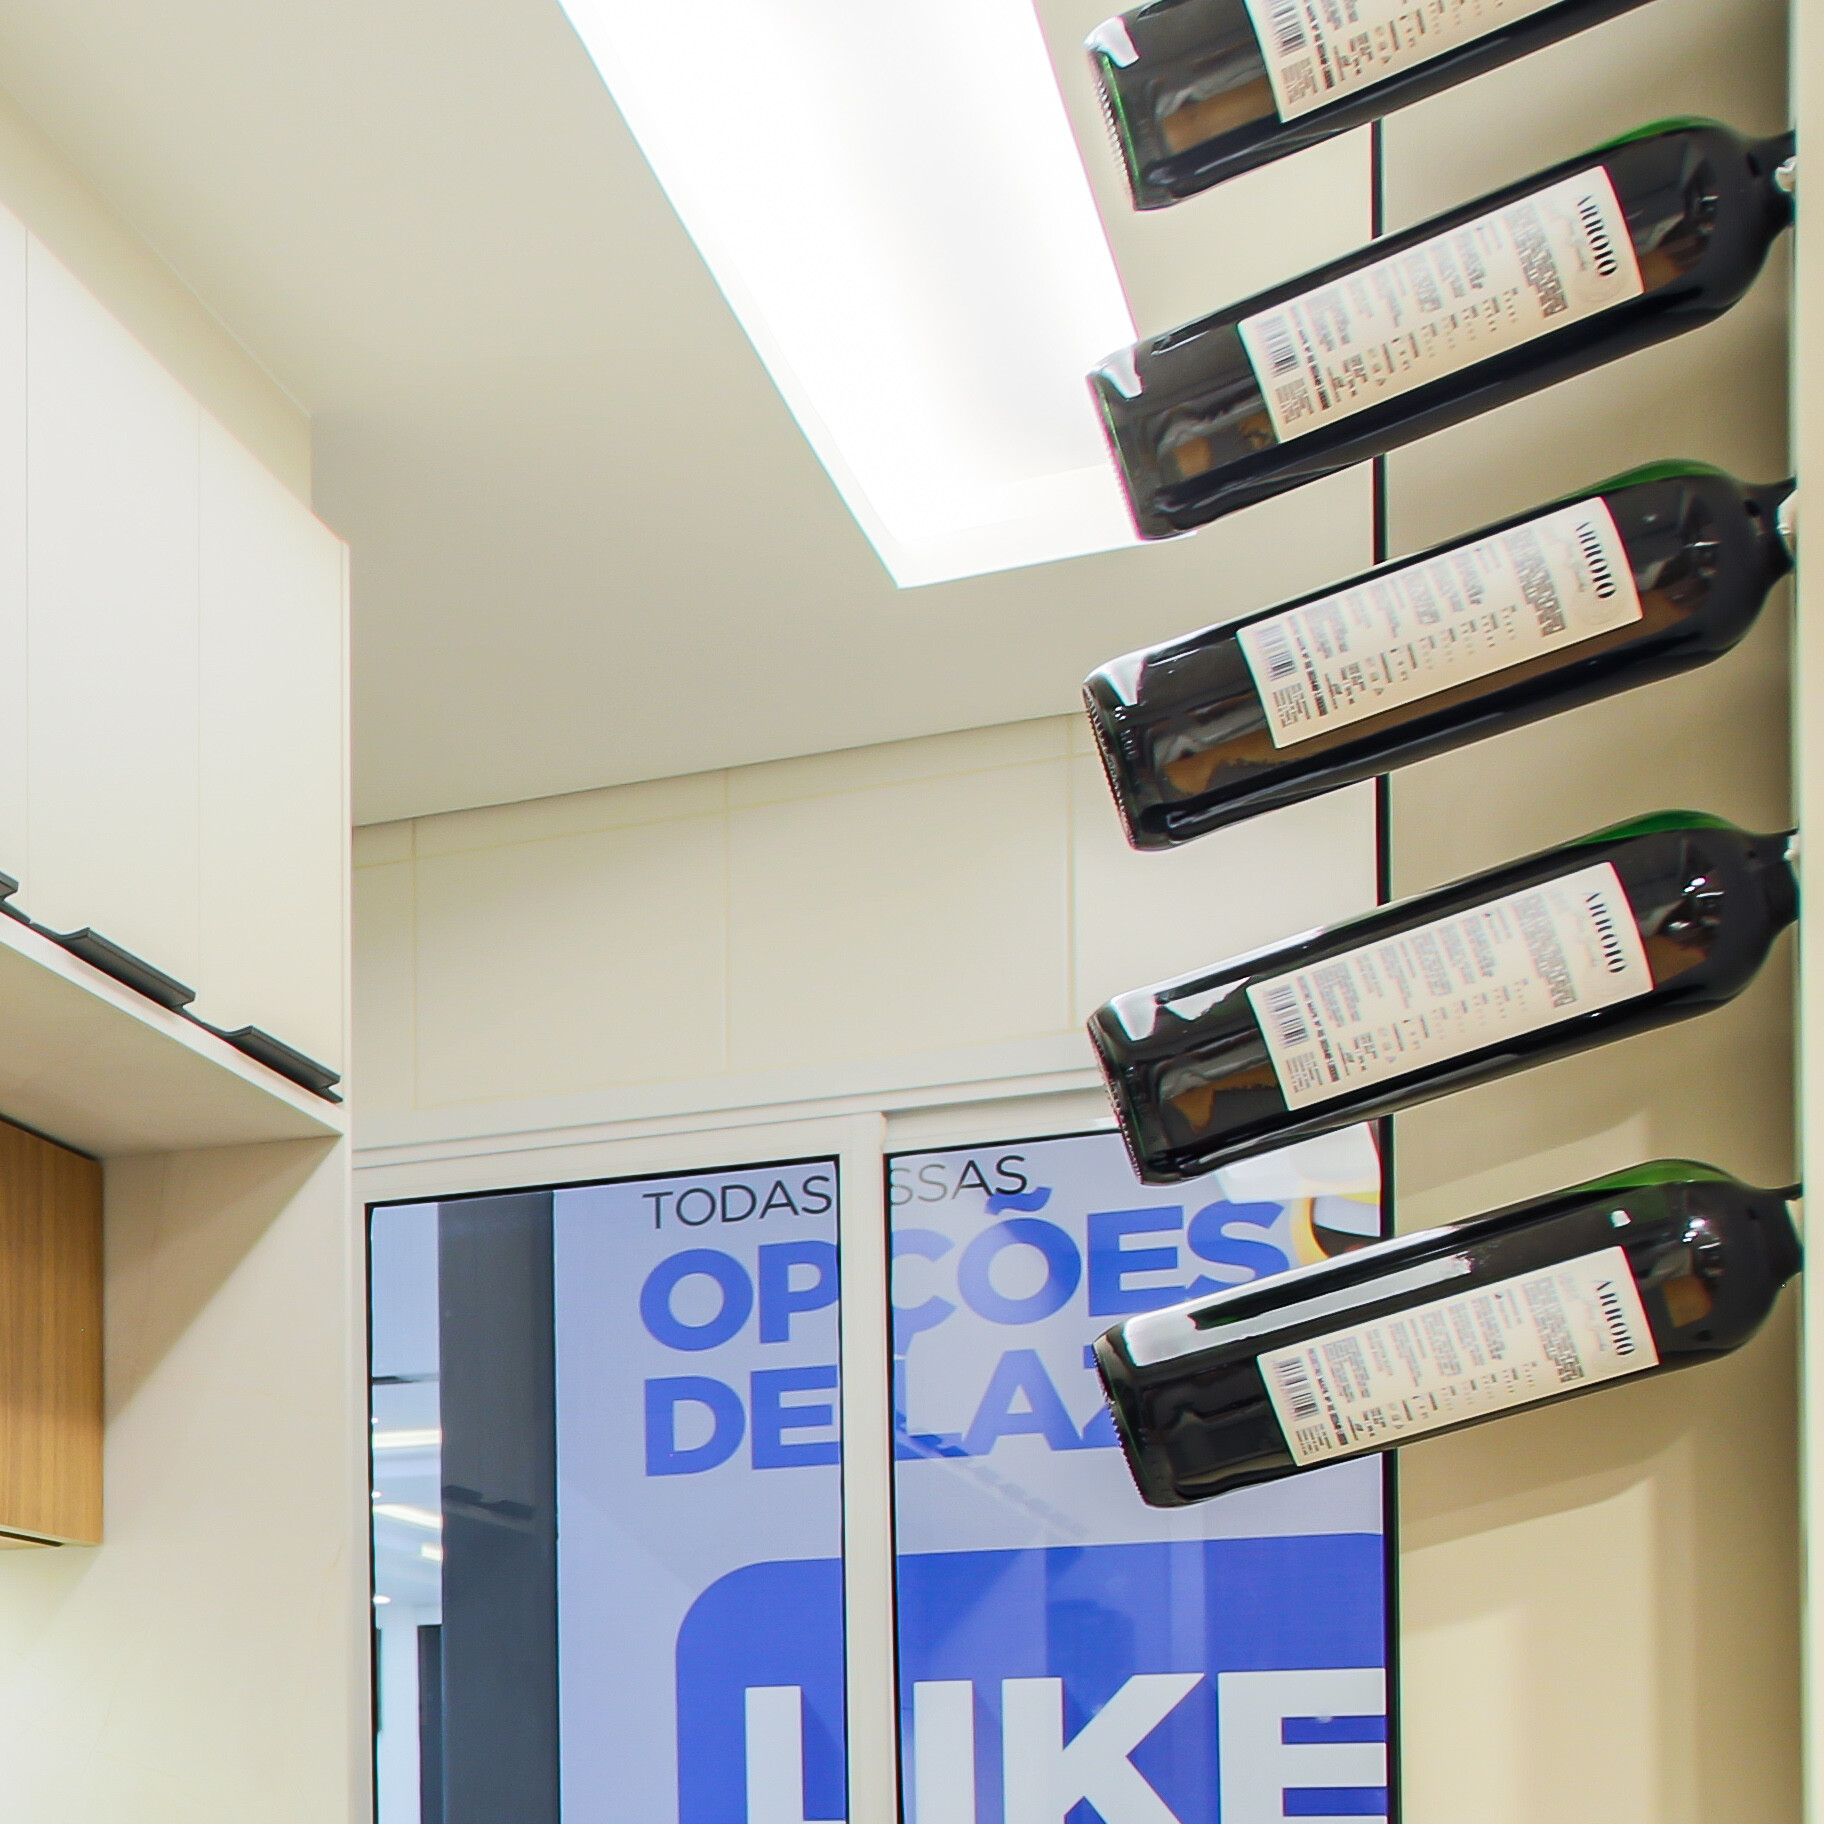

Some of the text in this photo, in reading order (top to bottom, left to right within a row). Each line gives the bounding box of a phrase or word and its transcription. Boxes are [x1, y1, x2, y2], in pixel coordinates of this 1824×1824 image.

[642, 1154, 1028, 1230] TODAS SSAS
[640, 1186, 1290, 1357] OPÇÕES
[644, 1344, 1122, 1477] DE LA
